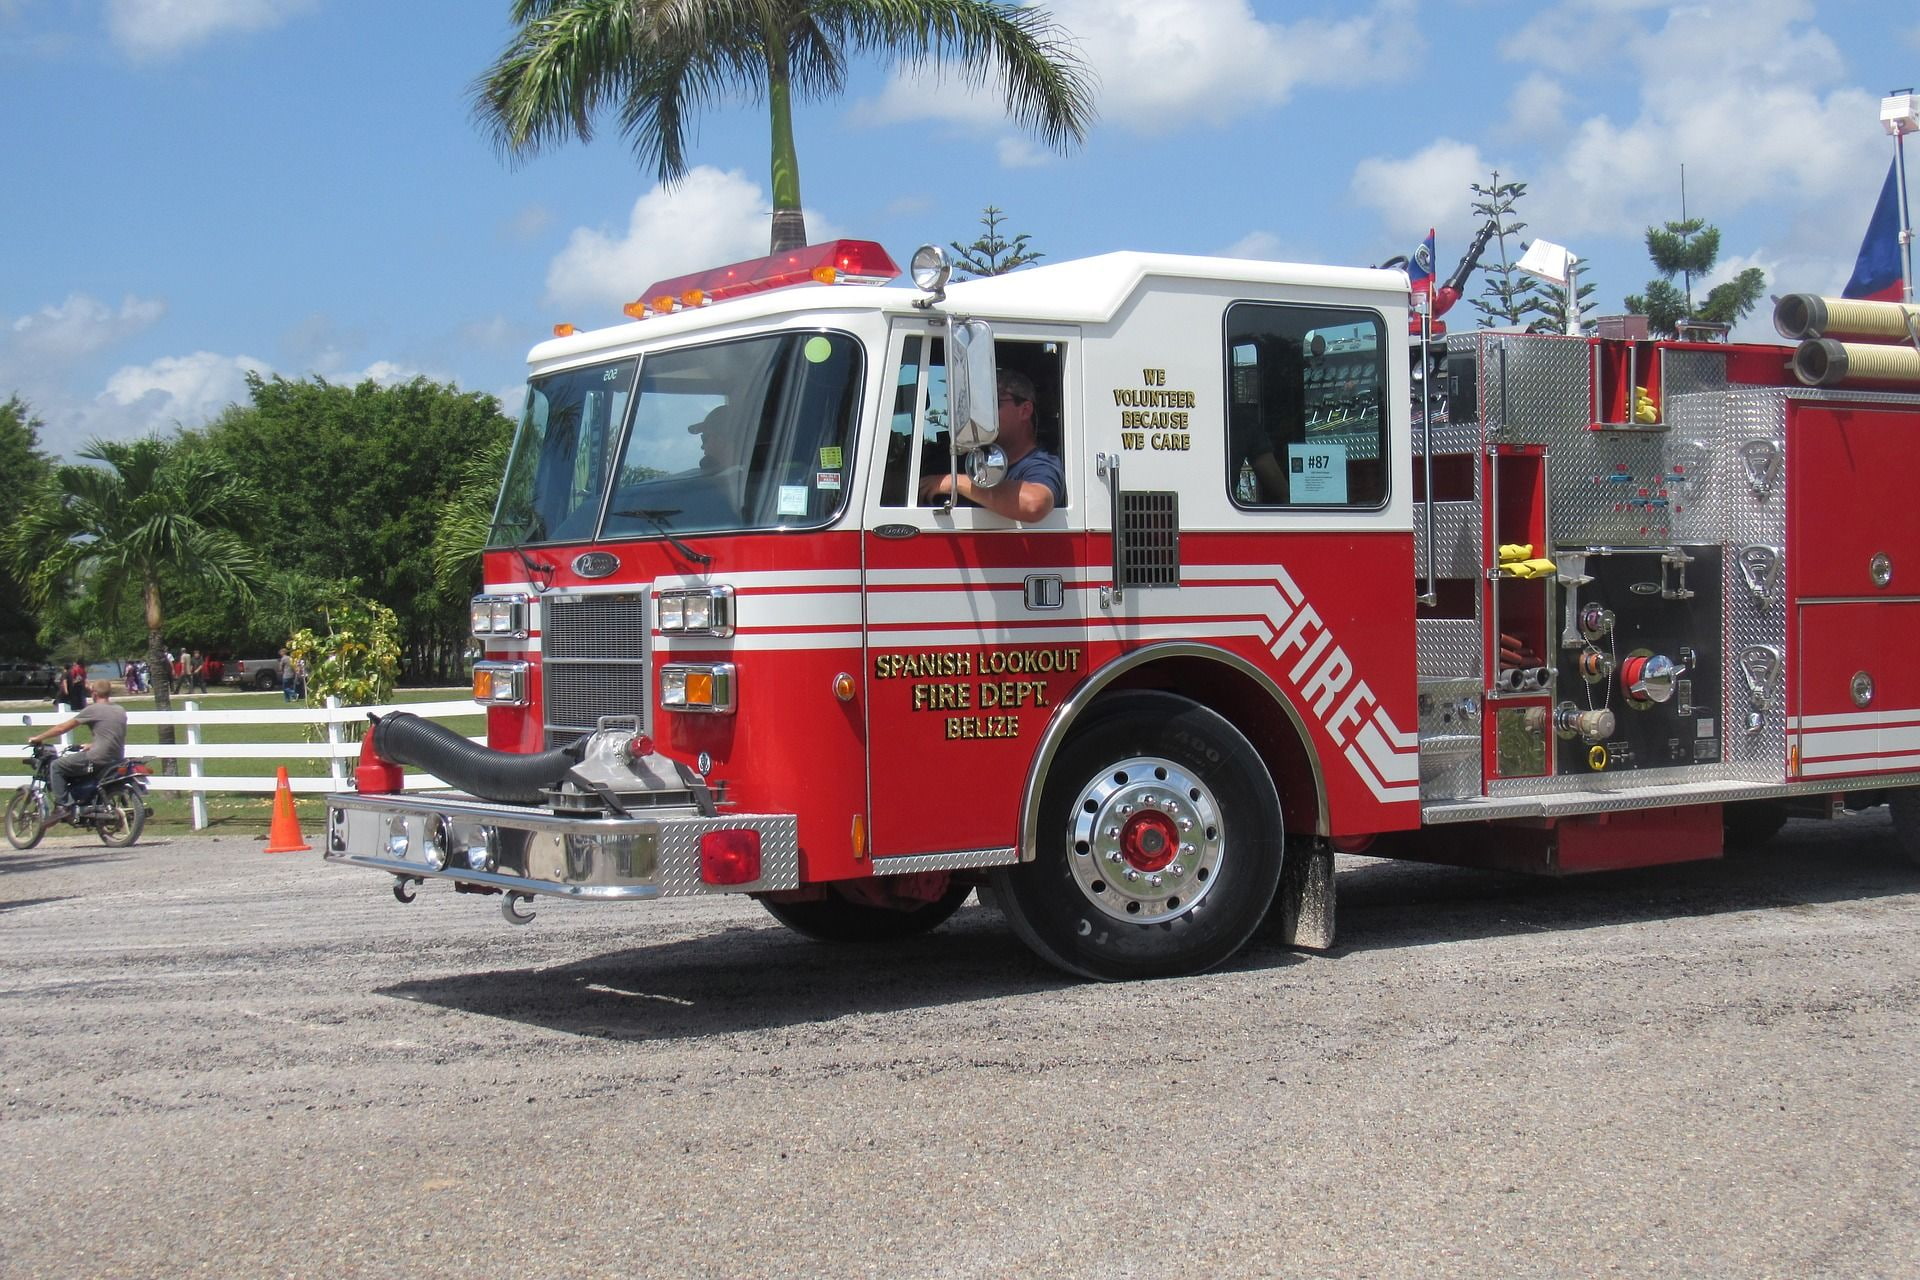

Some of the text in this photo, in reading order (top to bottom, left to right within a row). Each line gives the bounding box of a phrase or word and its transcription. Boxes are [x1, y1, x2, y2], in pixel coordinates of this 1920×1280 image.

[1143, 368, 1166, 386] WE
[1113, 389, 1196, 408] VOLUNTEER
[1122, 411, 1189, 429] BECAUSE
[1121, 432, 1191, 451] WE CARE
[1308, 455, 1330, 469] #87
[876, 649, 1080, 678] SPANISH LOOKOUT
[1270, 602, 1377, 747] FIRE
[913, 681, 1050, 711] FIRE DEPT.
[945, 716, 1019, 740] BELIZE
